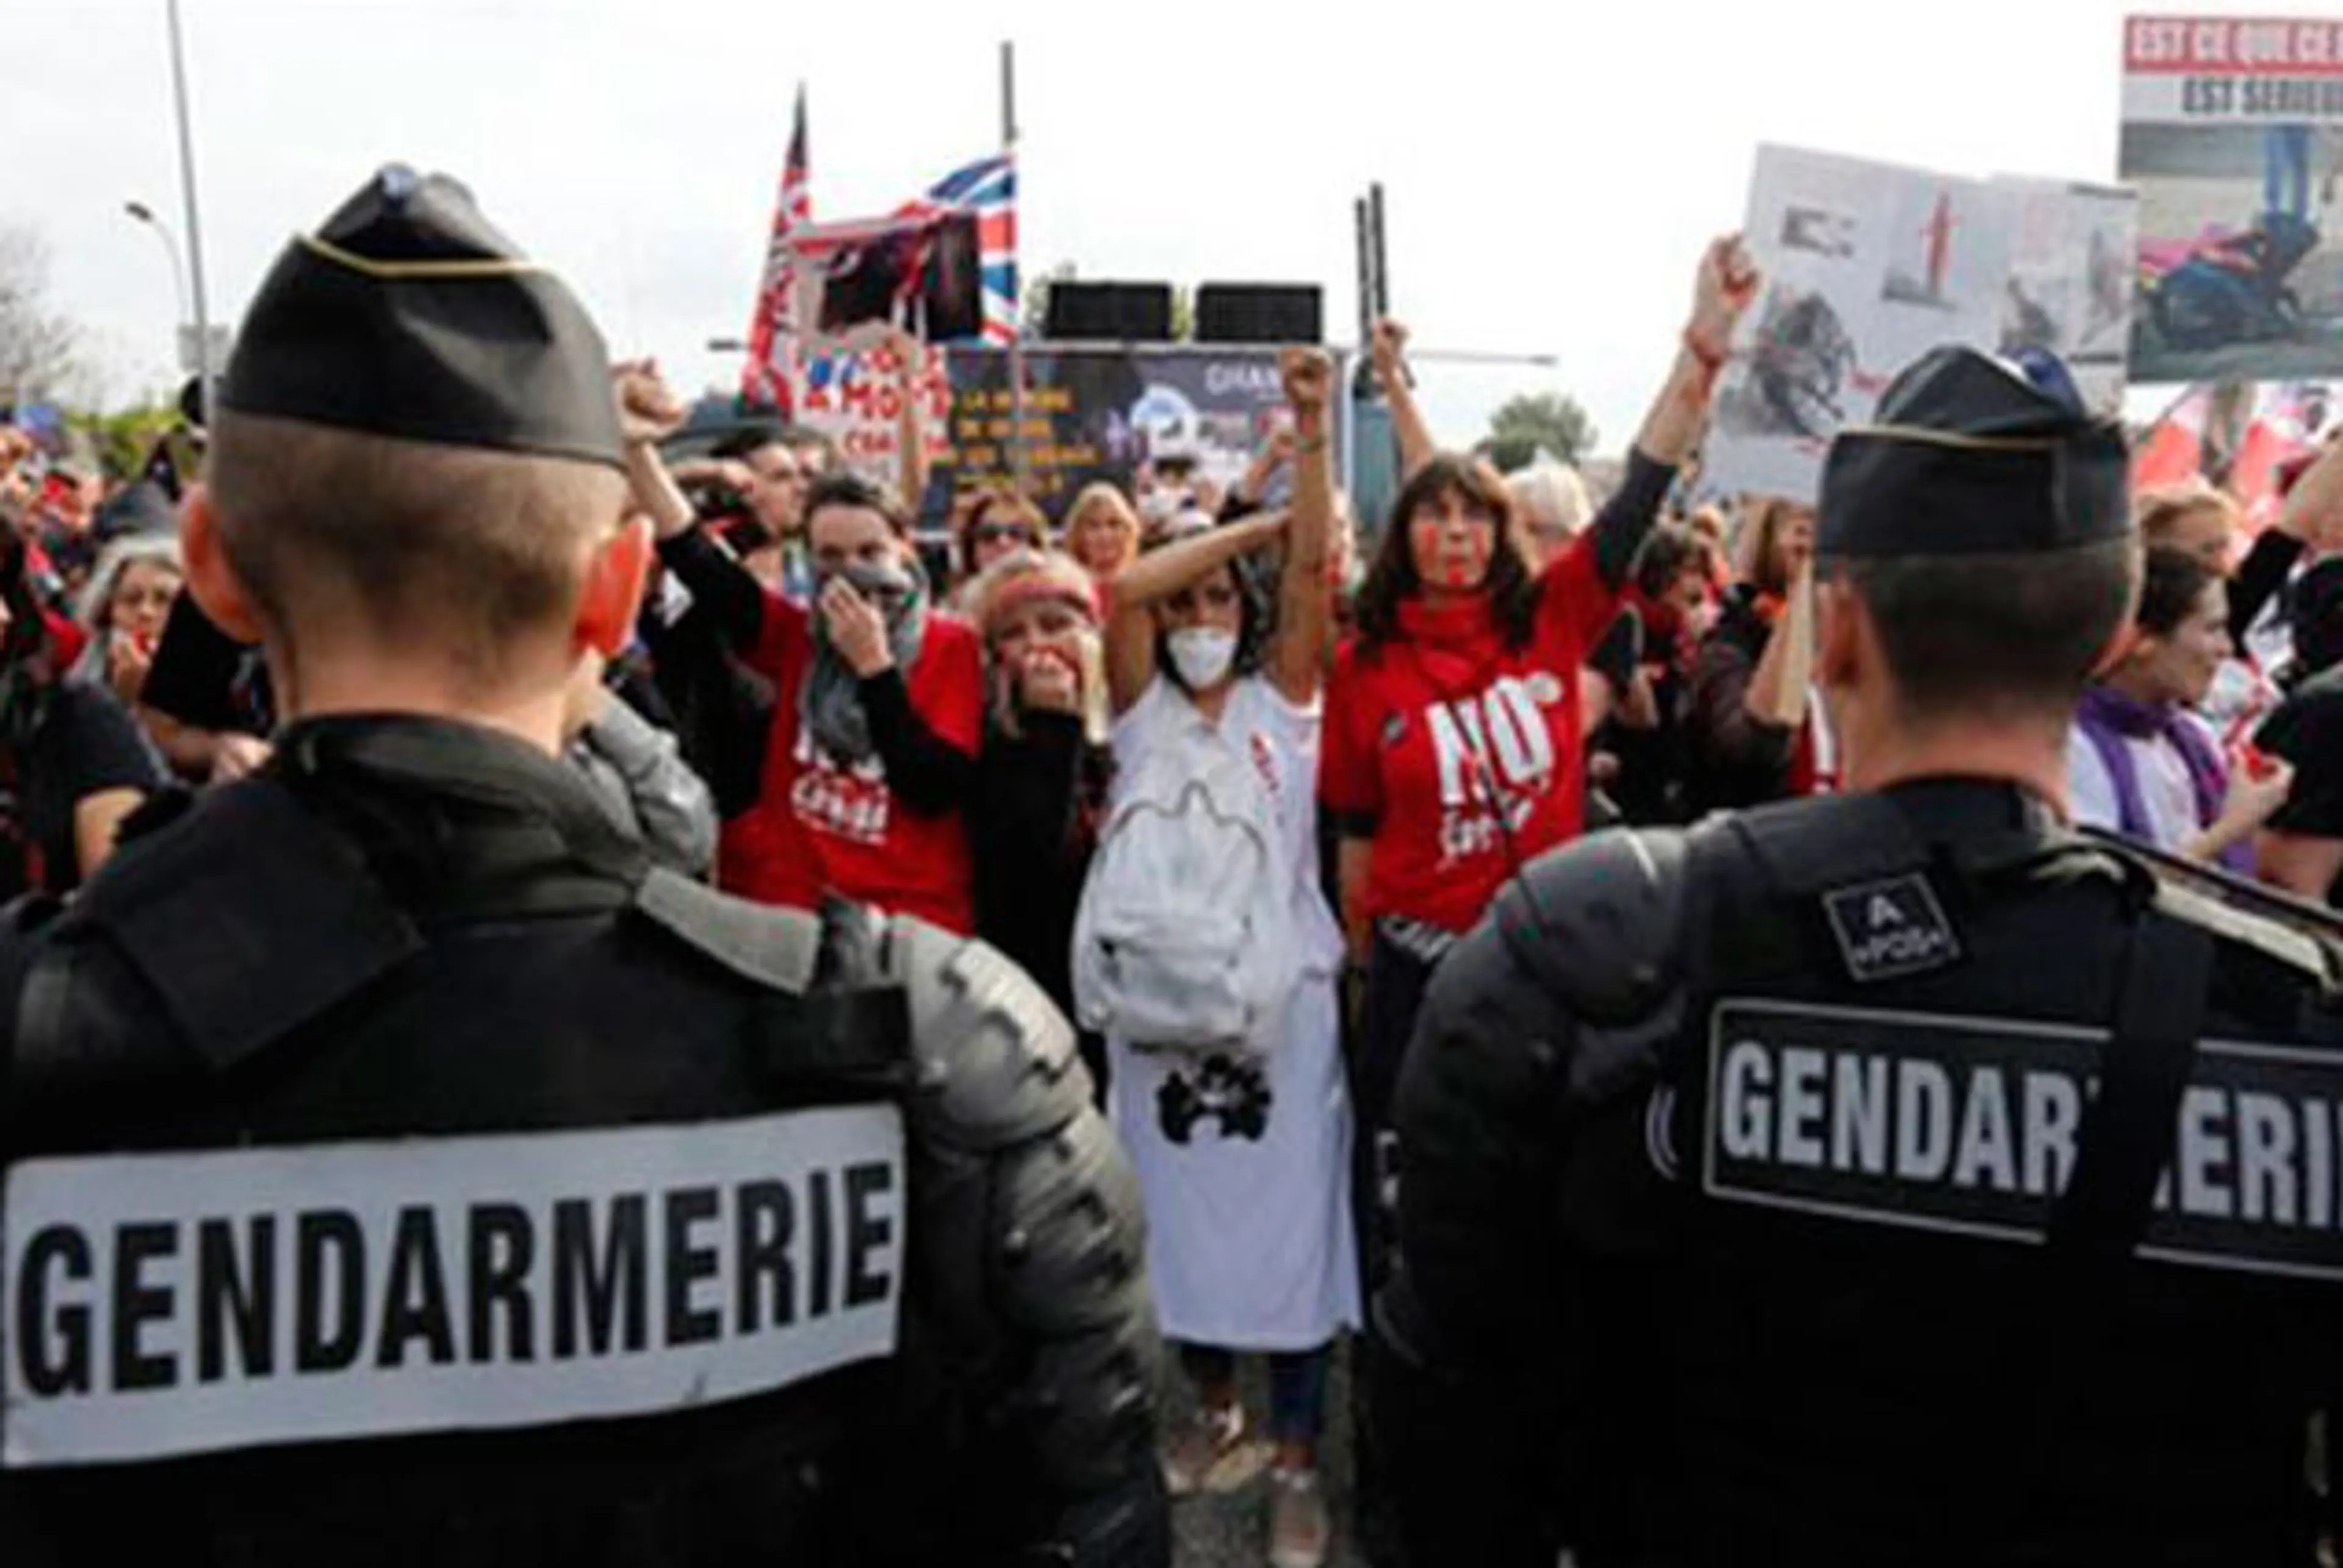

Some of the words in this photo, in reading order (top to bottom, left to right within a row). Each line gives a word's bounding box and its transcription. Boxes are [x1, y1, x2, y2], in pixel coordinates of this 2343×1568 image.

[2181, 76, 2233, 112] EST
[1868, 895, 1904, 927] A
[1722, 1040, 2343, 1229] GENDARERI
[17, 1162, 893, 1398] GENDARMERIE
